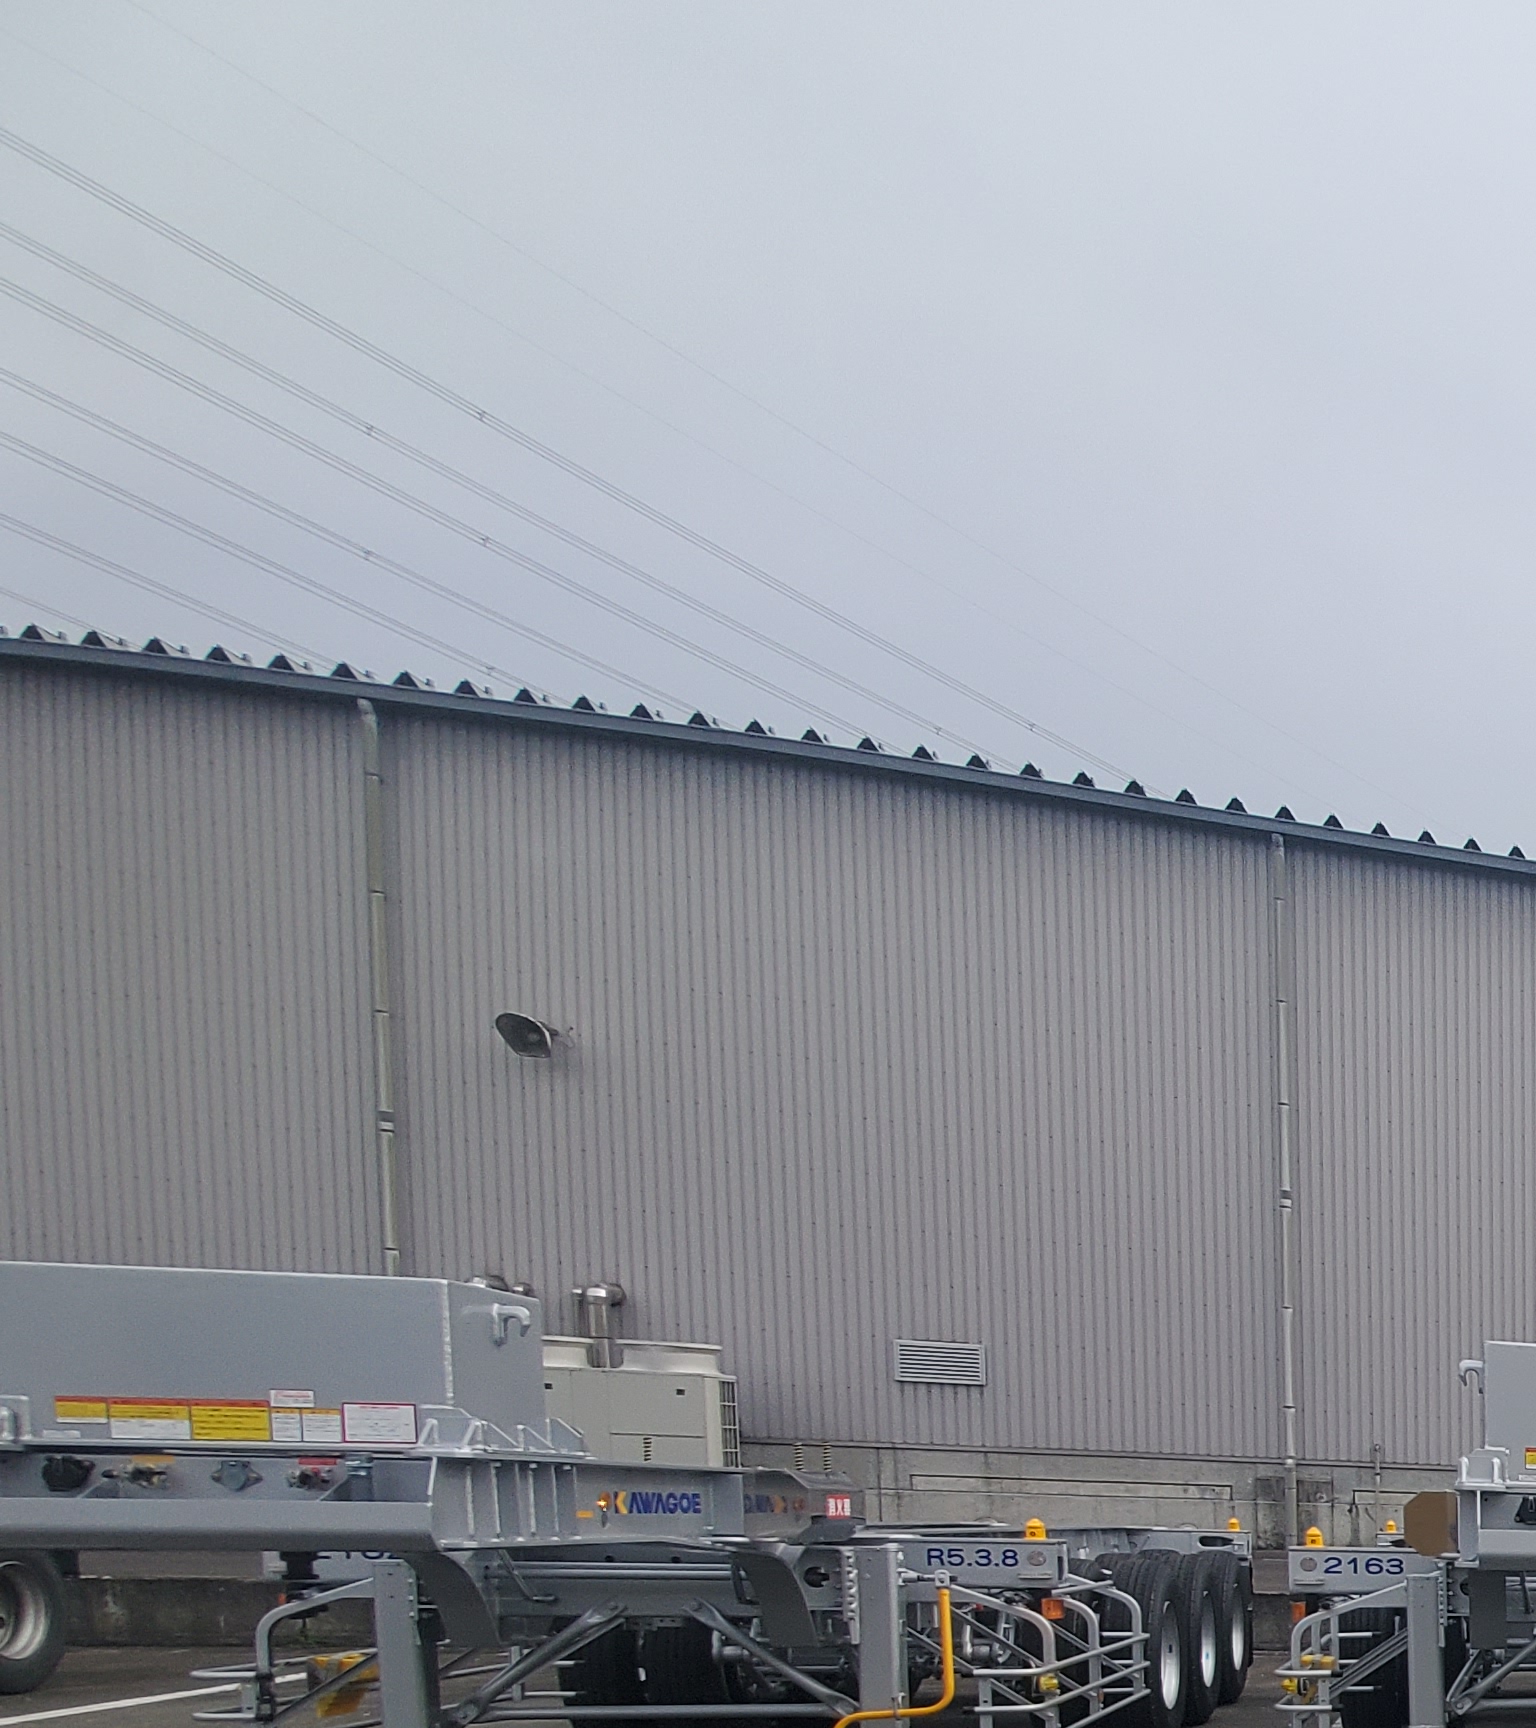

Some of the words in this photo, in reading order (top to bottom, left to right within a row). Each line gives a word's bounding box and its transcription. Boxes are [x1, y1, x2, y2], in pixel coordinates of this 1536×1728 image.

[614, 1491, 701, 1514] KAWAGOE
[927, 1548, 1018, 1567] R5.3.8
[1324, 1556, 1404, 1575] 2163
